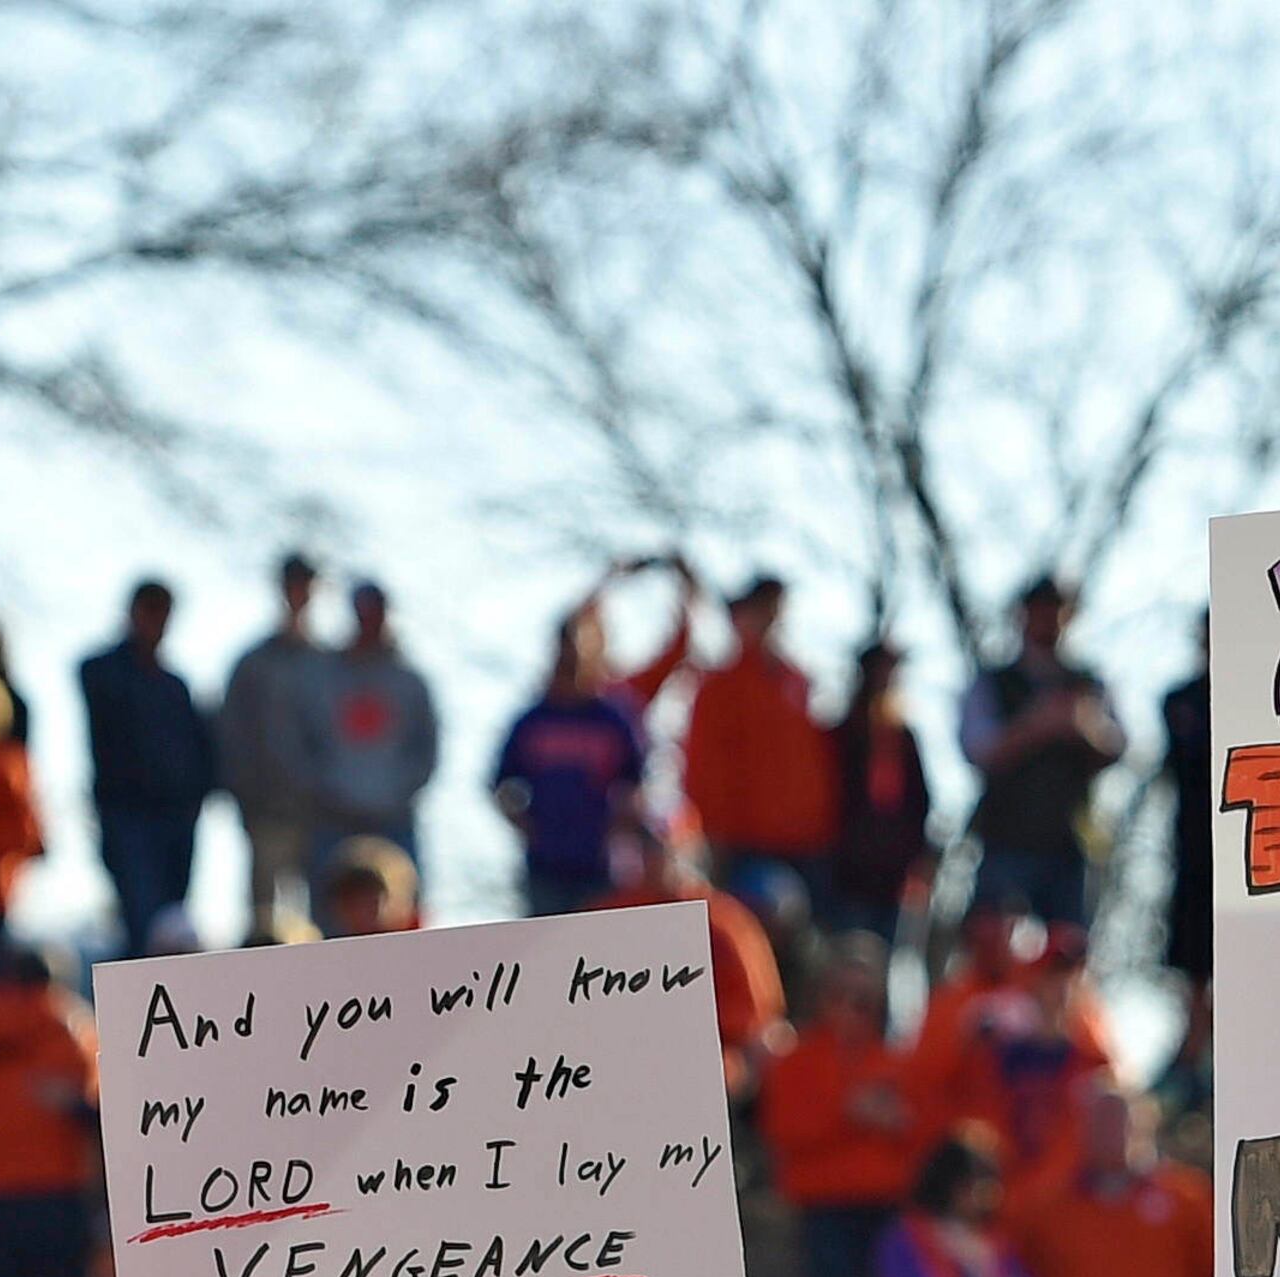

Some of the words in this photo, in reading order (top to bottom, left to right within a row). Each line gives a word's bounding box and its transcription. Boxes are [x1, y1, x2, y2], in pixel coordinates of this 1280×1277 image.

[139, 983, 255, 1057] And
[304, 994, 392, 1060] you
[430, 962, 520, 1015] will
[568, 956, 705, 1004] know
[140, 1096, 205, 1143] my
[265, 1085, 369, 1118] name
[403, 1062, 458, 1112] is
[515, 1054, 592, 1110] the
[145, 1158, 314, 1224] LORD
[357, 1159, 457, 1195] when
[484, 1140, 516, 1190] I
[558, 1142, 626, 1195] lay
[658, 1136, 722, 1188] my
